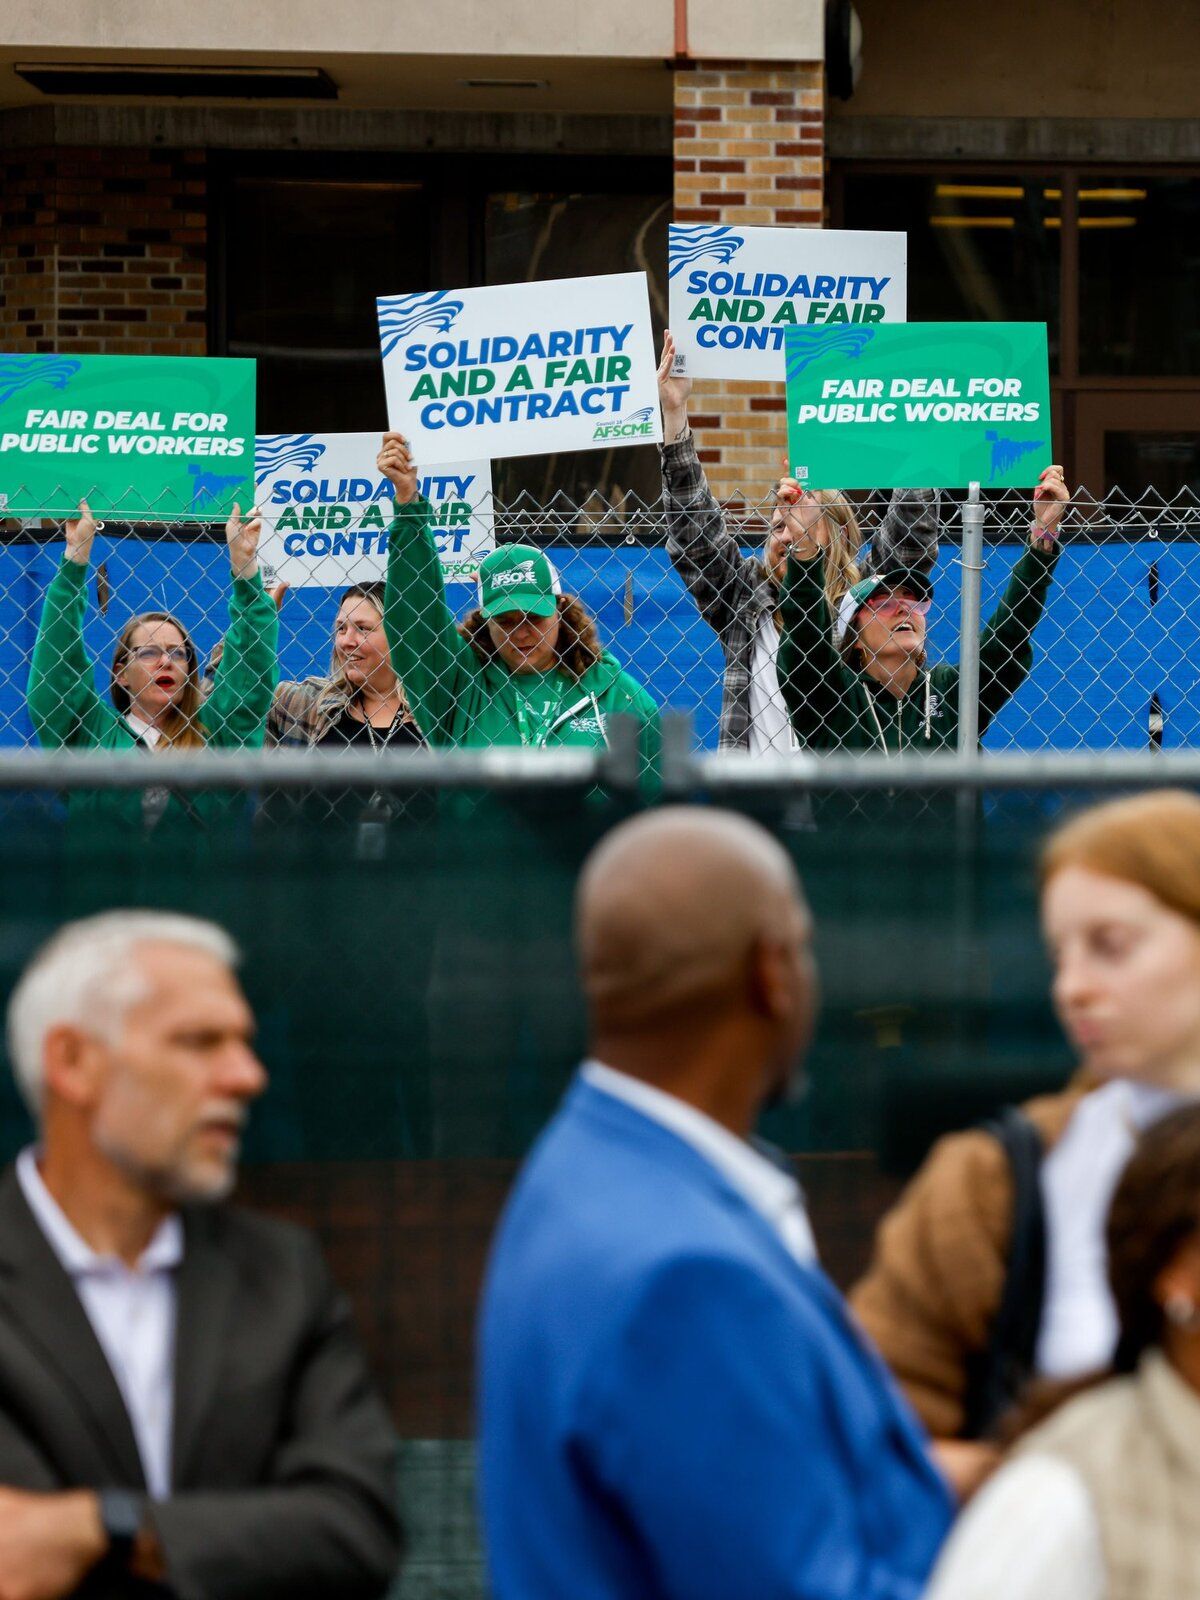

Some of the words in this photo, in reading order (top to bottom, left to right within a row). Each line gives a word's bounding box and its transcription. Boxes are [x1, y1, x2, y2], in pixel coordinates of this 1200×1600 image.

[687, 270, 891, 300] SOLIDARITY
[688, 298, 765, 323] AND
[771, 301, 797, 324] A
[807, 302, 886, 324] FAIR
[404, 323, 634, 372] SOLIDARITY
[696, 324, 784, 350] CONT
[409, 368, 496, 401] AND
[504, 364, 534, 392] A
[544, 355, 632, 388] FAIR
[821, 379, 884, 399] FAIR
[890, 378, 961, 398] DEAL
[967, 378, 1022, 397] FOR
[420, 384, 630, 430] CONTRACT
[797, 403, 897, 424] PUBLIC
[904, 402, 1040, 422] WORKERS
[24, 410, 88, 429] FAIR
[93, 411, 166, 430] DEAL
[171, 413, 228, 432] FOR
[593, 422, 654, 439] AFSCME
[0, 433, 100, 453] PUBLIC
[107, 434, 245, 456] WORKERS
[270, 475, 476, 504] SOLIDAITY
[276, 505, 346, 531] AND
[358, 505, 385, 530] A
[427, 503, 472, 527] IR
[283, 529, 470, 557] CONTCT
[440, 564, 480, 575] AFSCM
